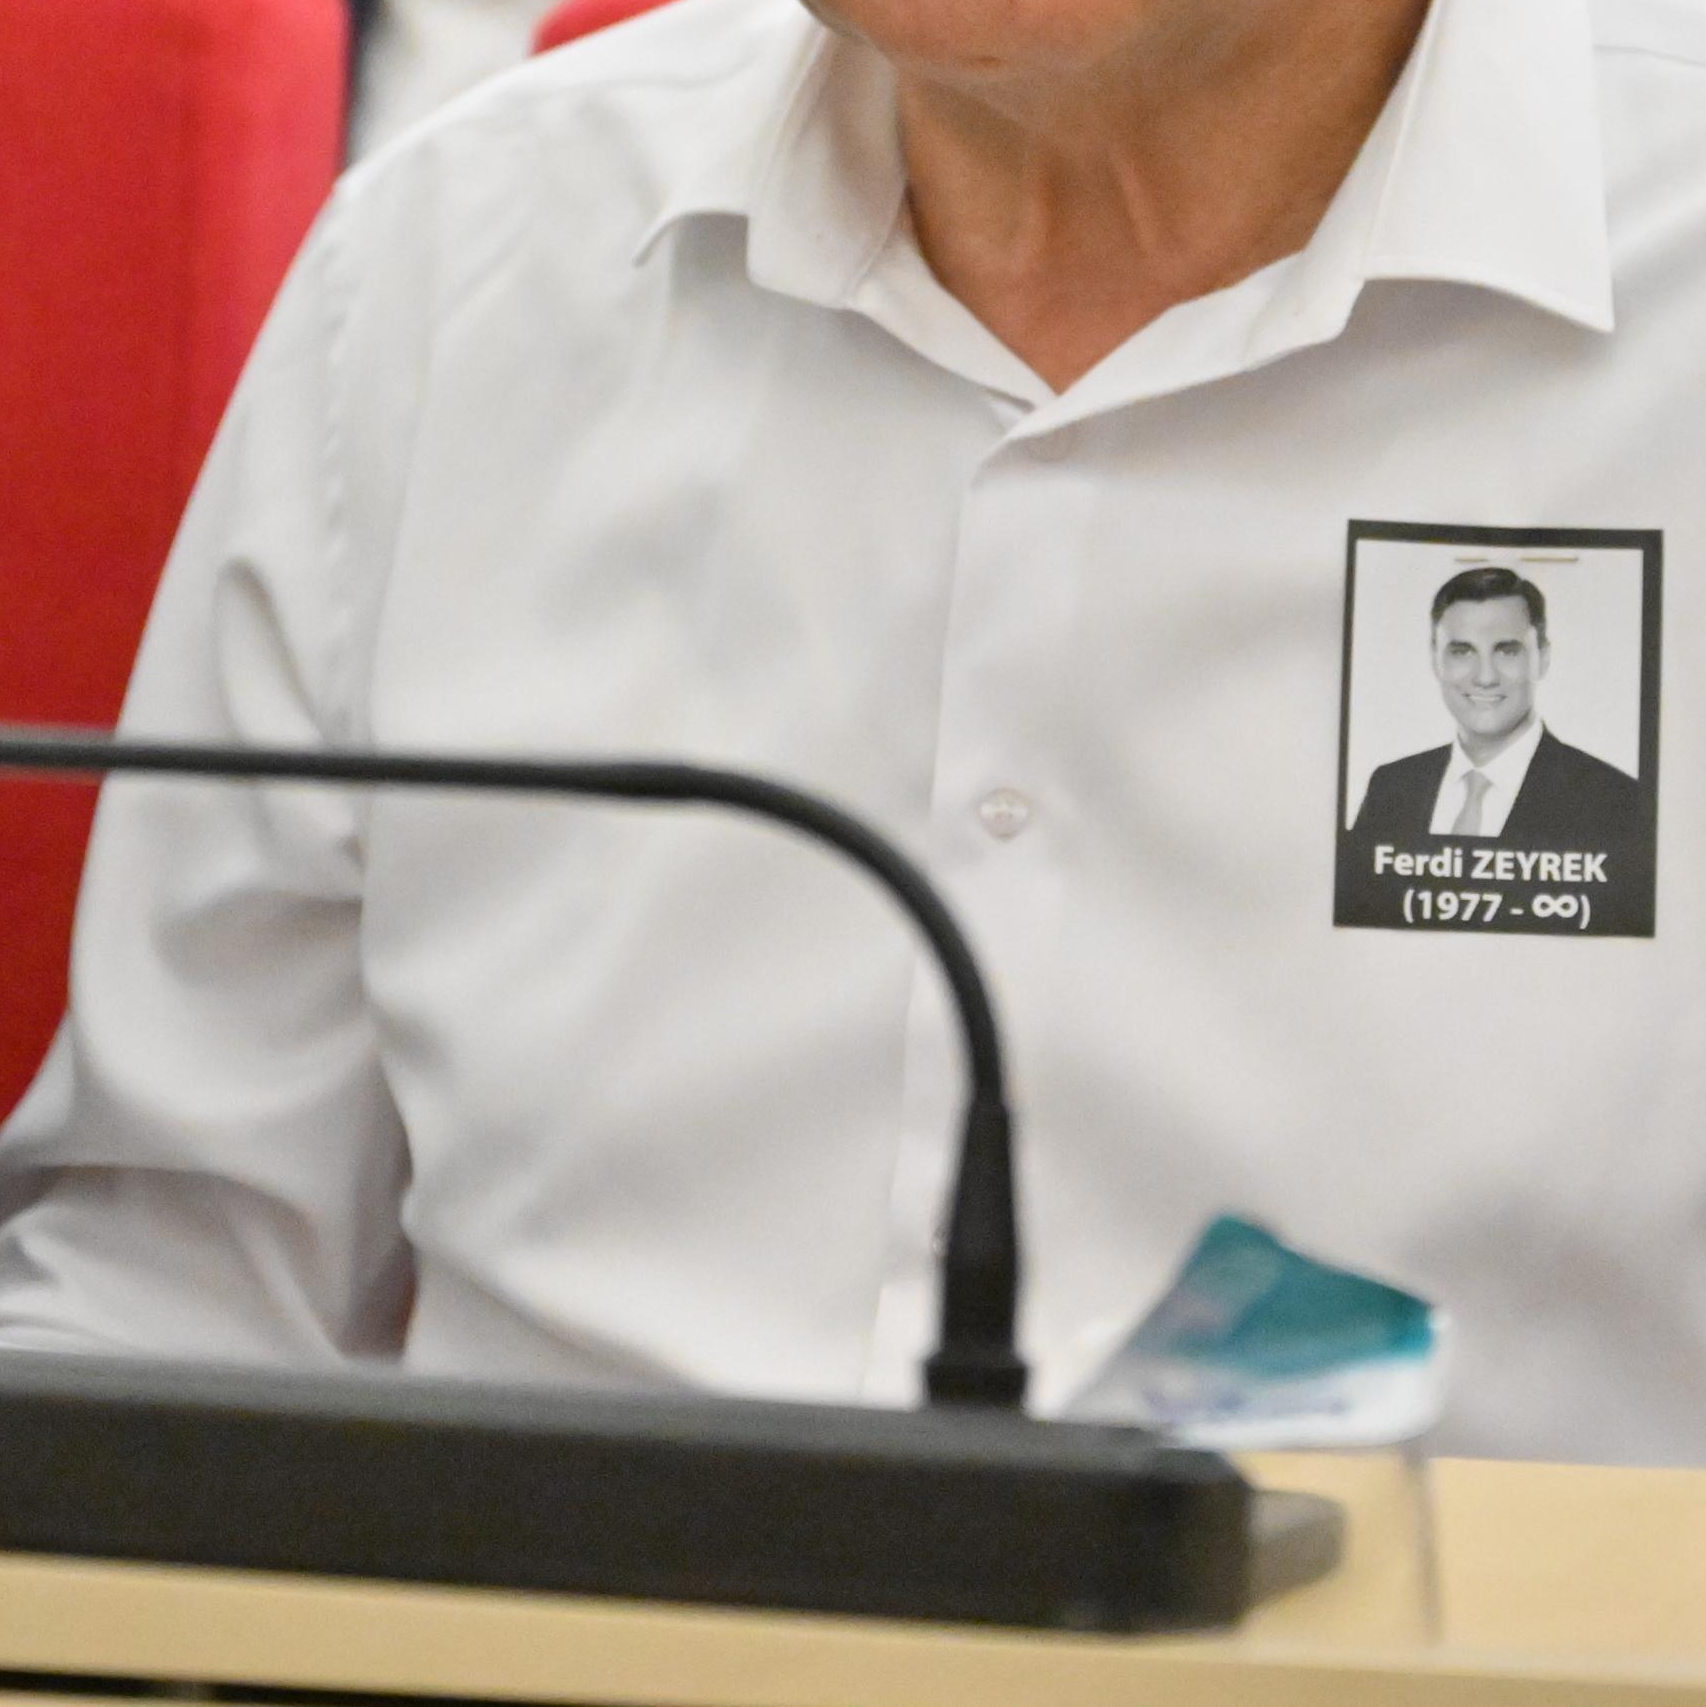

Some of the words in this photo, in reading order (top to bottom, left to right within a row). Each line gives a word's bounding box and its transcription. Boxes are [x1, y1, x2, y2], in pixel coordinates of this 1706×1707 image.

[1374, 845, 1463, 878] Ferdi
[1471, 849, 1608, 882] ZEYREK
[1403, 889, 1502, 923] (1977
